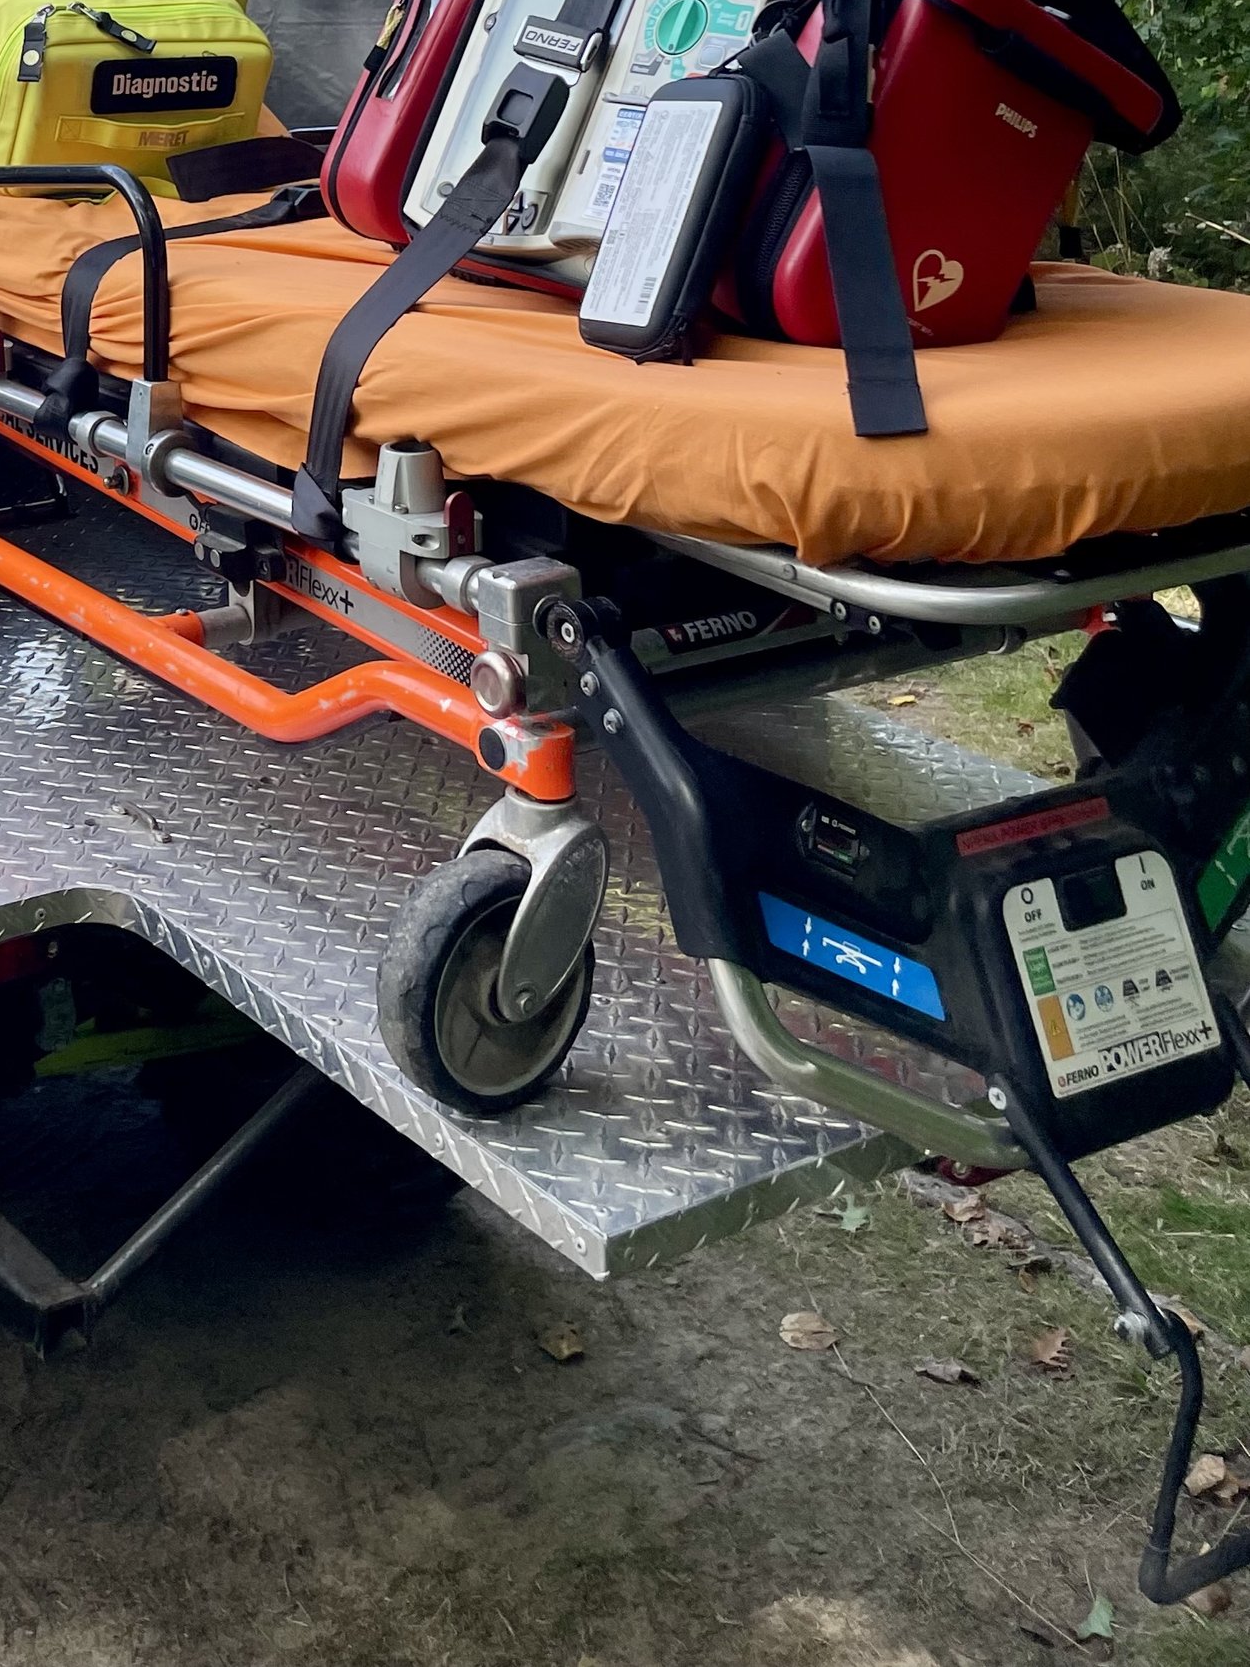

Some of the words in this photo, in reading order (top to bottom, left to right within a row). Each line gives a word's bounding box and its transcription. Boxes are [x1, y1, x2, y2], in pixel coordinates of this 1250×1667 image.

[524, 30, 581, 53] FERNO
[112, 70, 219, 99] Diagnostic
[995, 102, 1038, 138] PHILIPS
[138, 130, 190, 148] MERET
[285, 556, 355, 615] RFlexx+
[682, 611, 757, 643] FERNO
[1140, 878, 1156, 891] ON
[1024, 908, 1043, 923] OFF
[1066, 1064, 1100, 1085] FERNO
